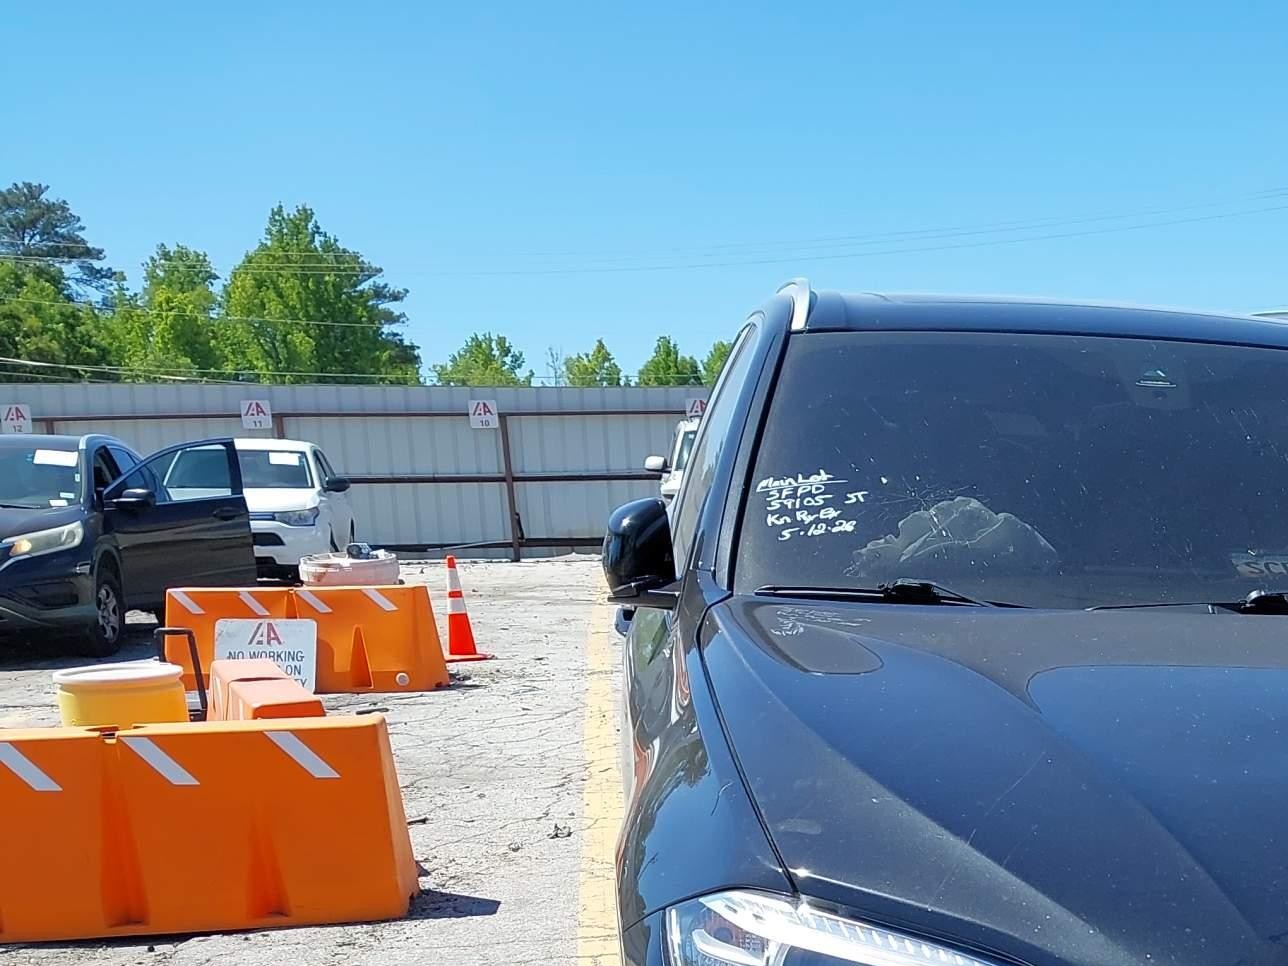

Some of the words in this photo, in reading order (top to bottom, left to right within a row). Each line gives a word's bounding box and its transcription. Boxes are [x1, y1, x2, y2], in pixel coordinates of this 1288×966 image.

[253, 420, 263, 428] 11
[480, 419, 490, 427] 10
[13, 424, 24, 433] 12
[285, 664, 303, 676] ON
